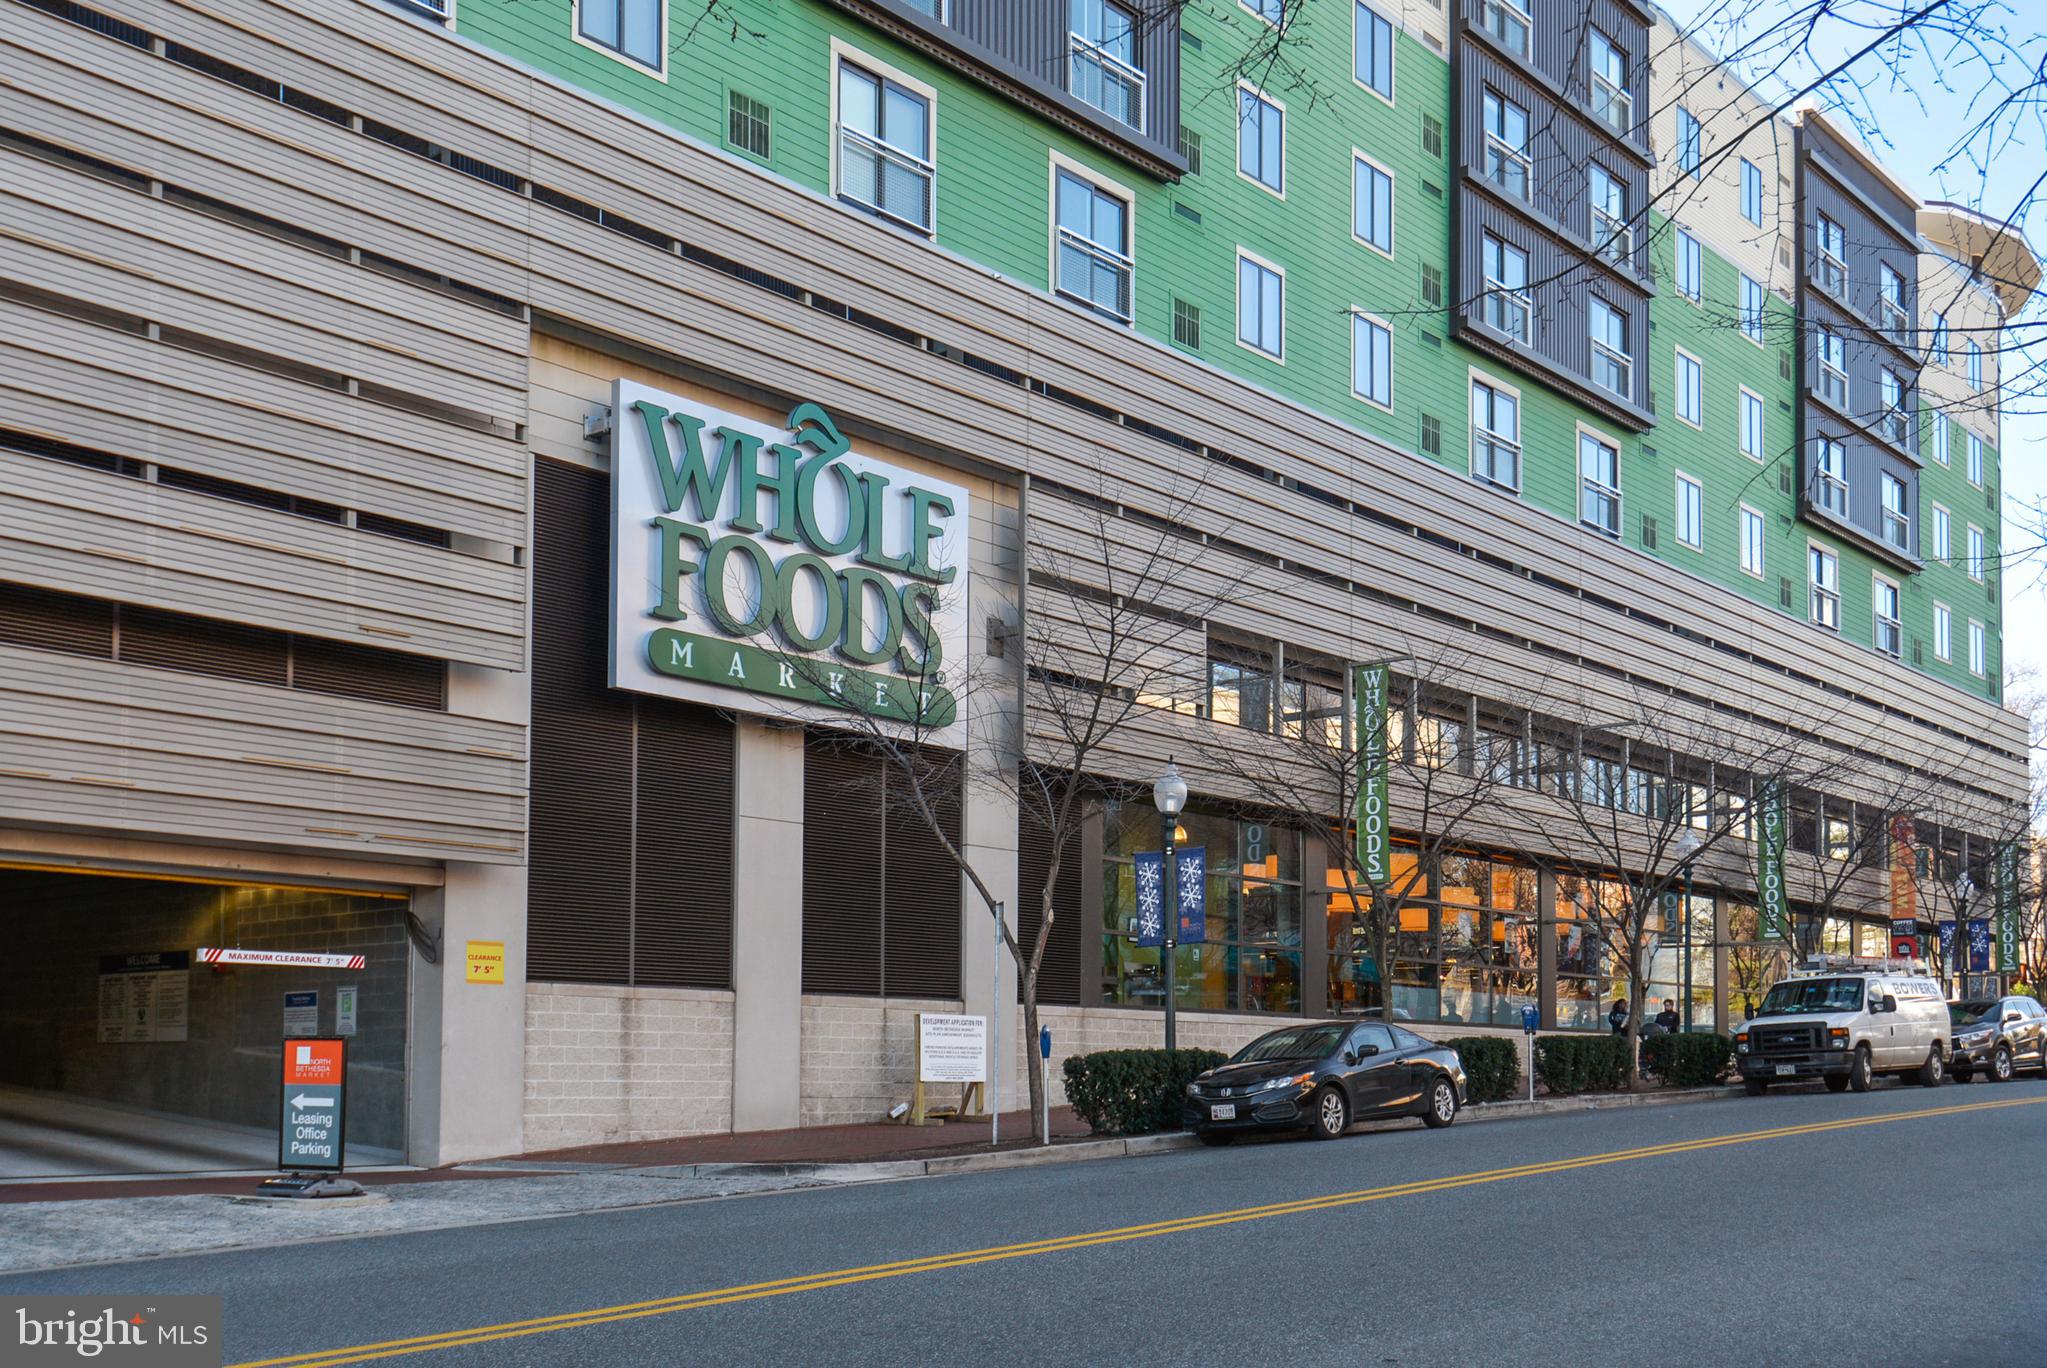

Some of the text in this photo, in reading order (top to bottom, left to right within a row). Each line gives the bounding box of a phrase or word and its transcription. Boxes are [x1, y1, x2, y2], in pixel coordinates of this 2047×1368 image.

[632, 400, 956, 584] WHOLE
[648, 516, 944, 678] FOODS
[670, 637, 933, 717] MARKET
[1363, 669, 1383, 772] WHOLE
[1365, 776, 1382, 873] FOODS
[1763, 781, 1778, 857] OLE
[228, 952, 273, 961] MAXIMUM
[275, 954, 322, 964] CLEARANCE
[1893, 982, 1938, 996] BOWERS
[291, 1112, 333, 1128] Leasing
[291, 1141, 331, 1158] Parking
[296, 1126, 328, 1140] Office
